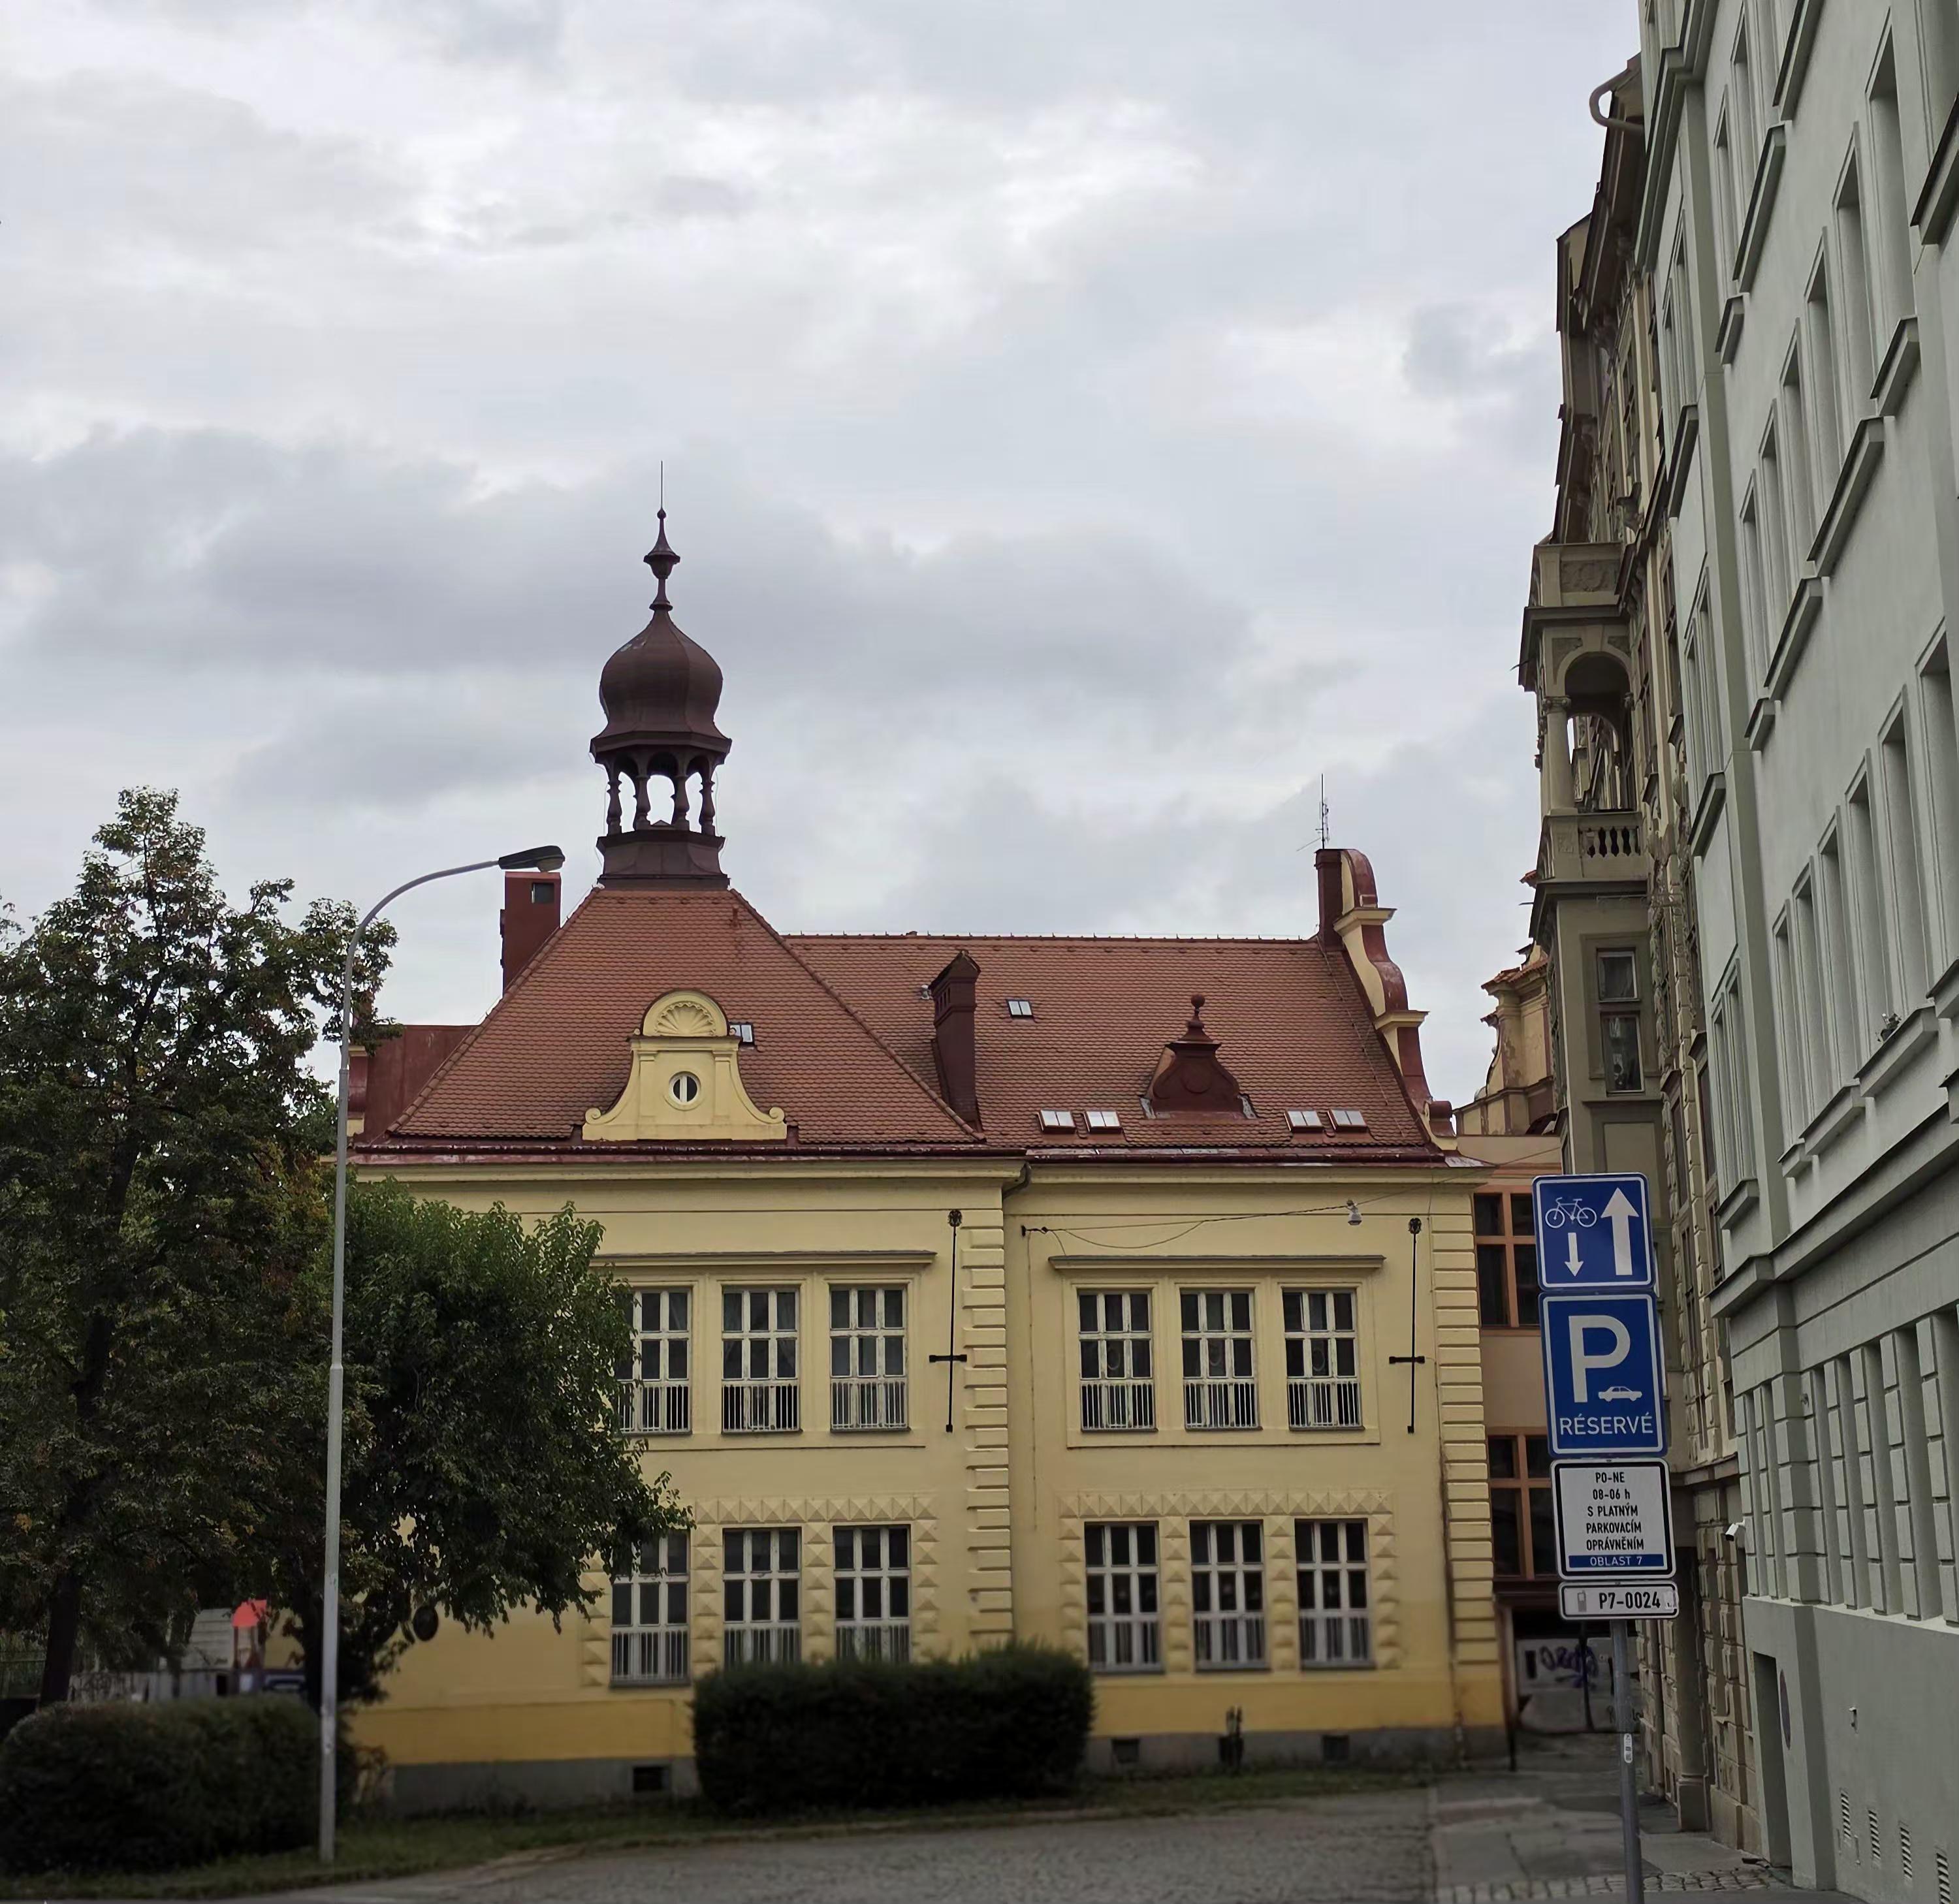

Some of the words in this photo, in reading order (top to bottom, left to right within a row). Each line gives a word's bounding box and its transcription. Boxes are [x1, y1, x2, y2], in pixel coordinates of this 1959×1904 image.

[1569, 1314, 1631, 1403] P
[1559, 1412, 1653, 1436] RÉSERVÉ
[1595, 1472, 1625, 1484] PO-NE
[1593, 1489, 1621, 1500] 08-06
[1625, 1489, 1631, 1500] h
[1587, 1506, 1593, 1517] S
[1597, 1502, 1638, 1517] PLATNÝM
[1586, 1519, 1642, 1534] PARKOVACÍM
[1586, 1536, 1644, 1551] OPRÁVNĚNÍM
[1590, 1557, 1631, 1566] OBLAST
[1636, 1556, 1642, 1565] 7
[1599, 1592, 1661, 1609] P7-0024
